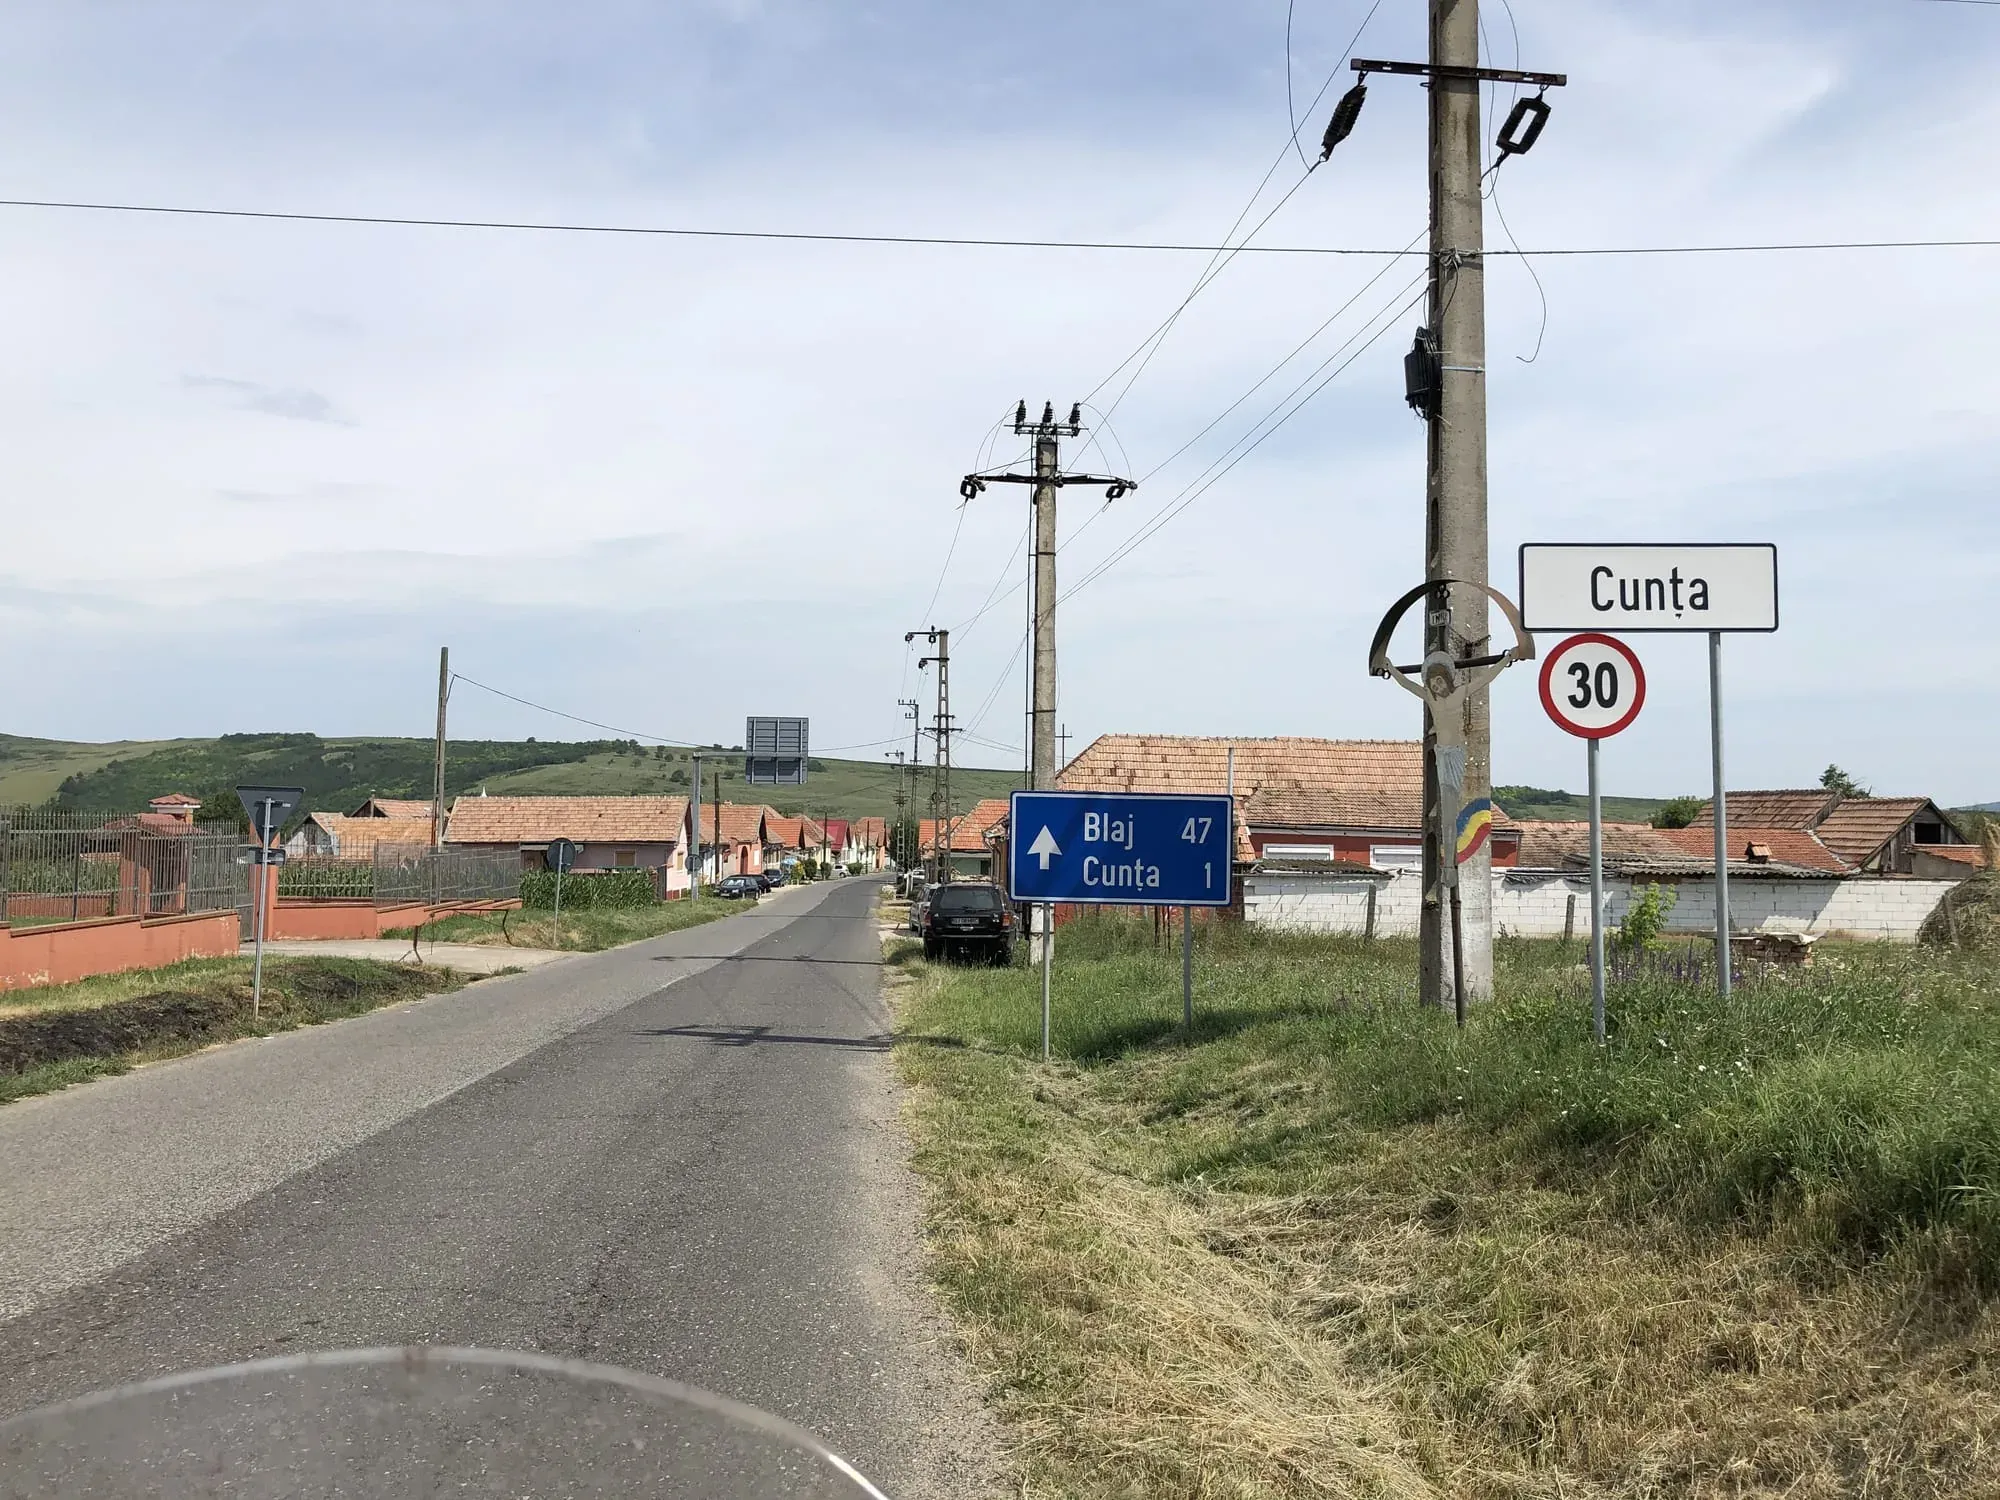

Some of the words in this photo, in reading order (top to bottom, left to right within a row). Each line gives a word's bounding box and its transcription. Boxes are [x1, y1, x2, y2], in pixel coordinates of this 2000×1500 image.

[1591, 566, 1709, 618] Cunța
[1568, 662, 1619, 708] 30
[1084, 812, 1134, 850] Blaj
[1181, 817, 1212, 844] 47
[1083, 856, 1160, 892] Cunța
[1204, 862, 1212, 889] 1
